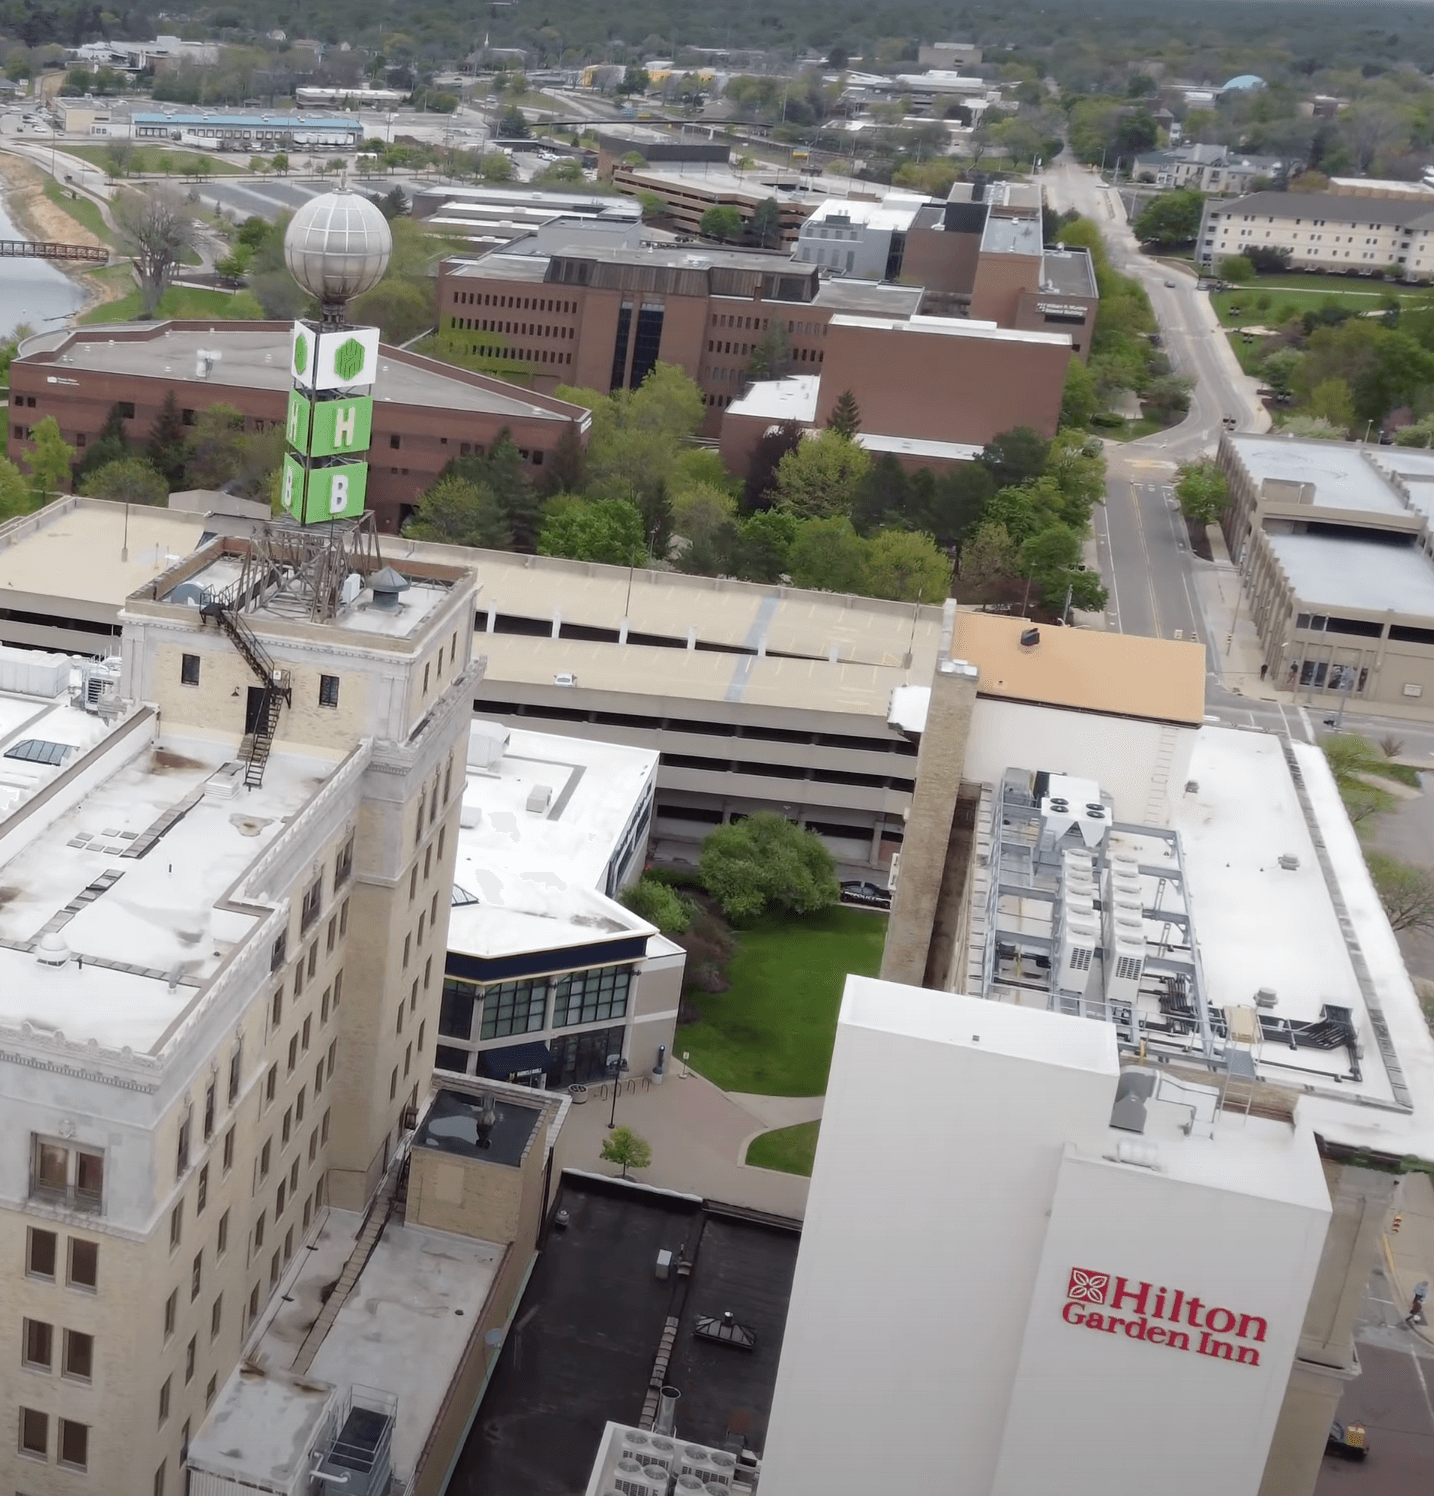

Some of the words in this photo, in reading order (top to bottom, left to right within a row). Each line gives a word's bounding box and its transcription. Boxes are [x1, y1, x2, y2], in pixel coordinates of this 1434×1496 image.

[334, 406, 356, 447] H
[330, 475, 349, 514] B
[1062, 1301, 1190, 1351] Garden
[1195, 1330, 1260, 1367] Inn
[1110, 1275, 1268, 1343] Hilton
